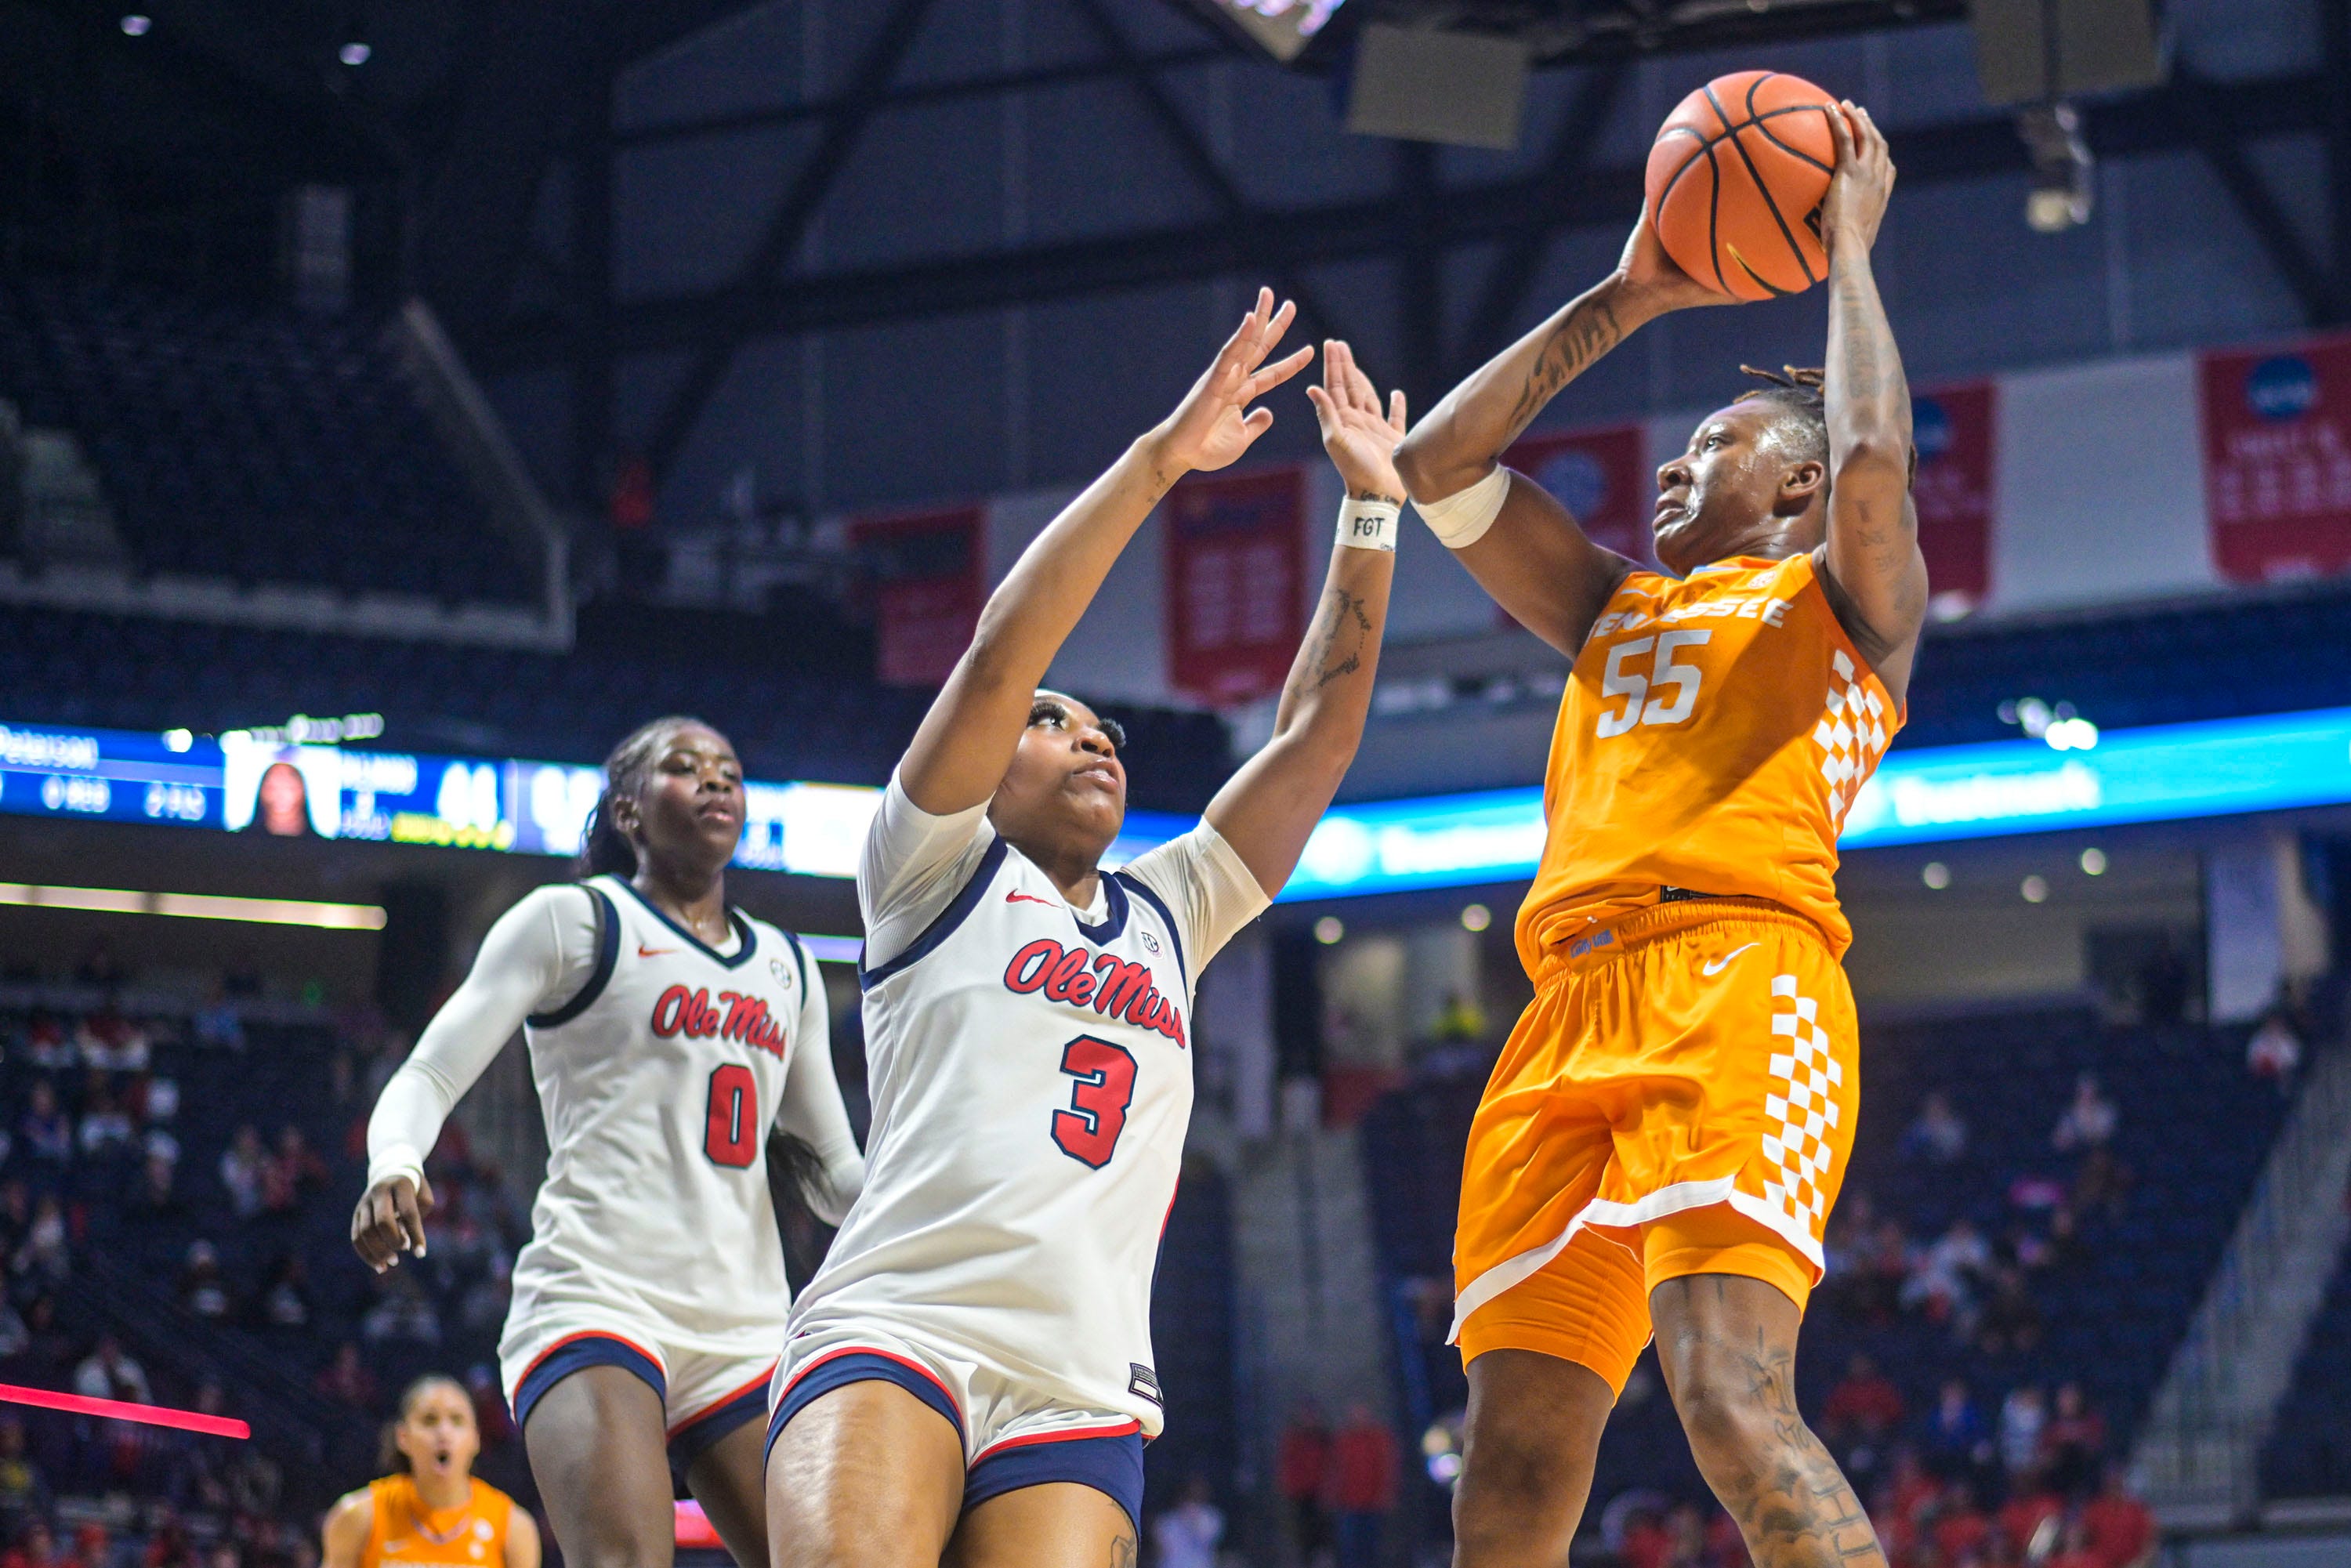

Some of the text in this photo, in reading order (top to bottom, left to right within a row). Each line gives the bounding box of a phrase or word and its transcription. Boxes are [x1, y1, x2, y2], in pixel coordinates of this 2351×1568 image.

[1353, 516, 1386, 538] FGT
[1596, 629, 1712, 739] 55
[652, 983, 719, 1039] Ole
[1004, 939, 1185, 1049] Ole Miss
[704, 1063, 759, 1169] 0
[1051, 1034, 1139, 1171] 3
